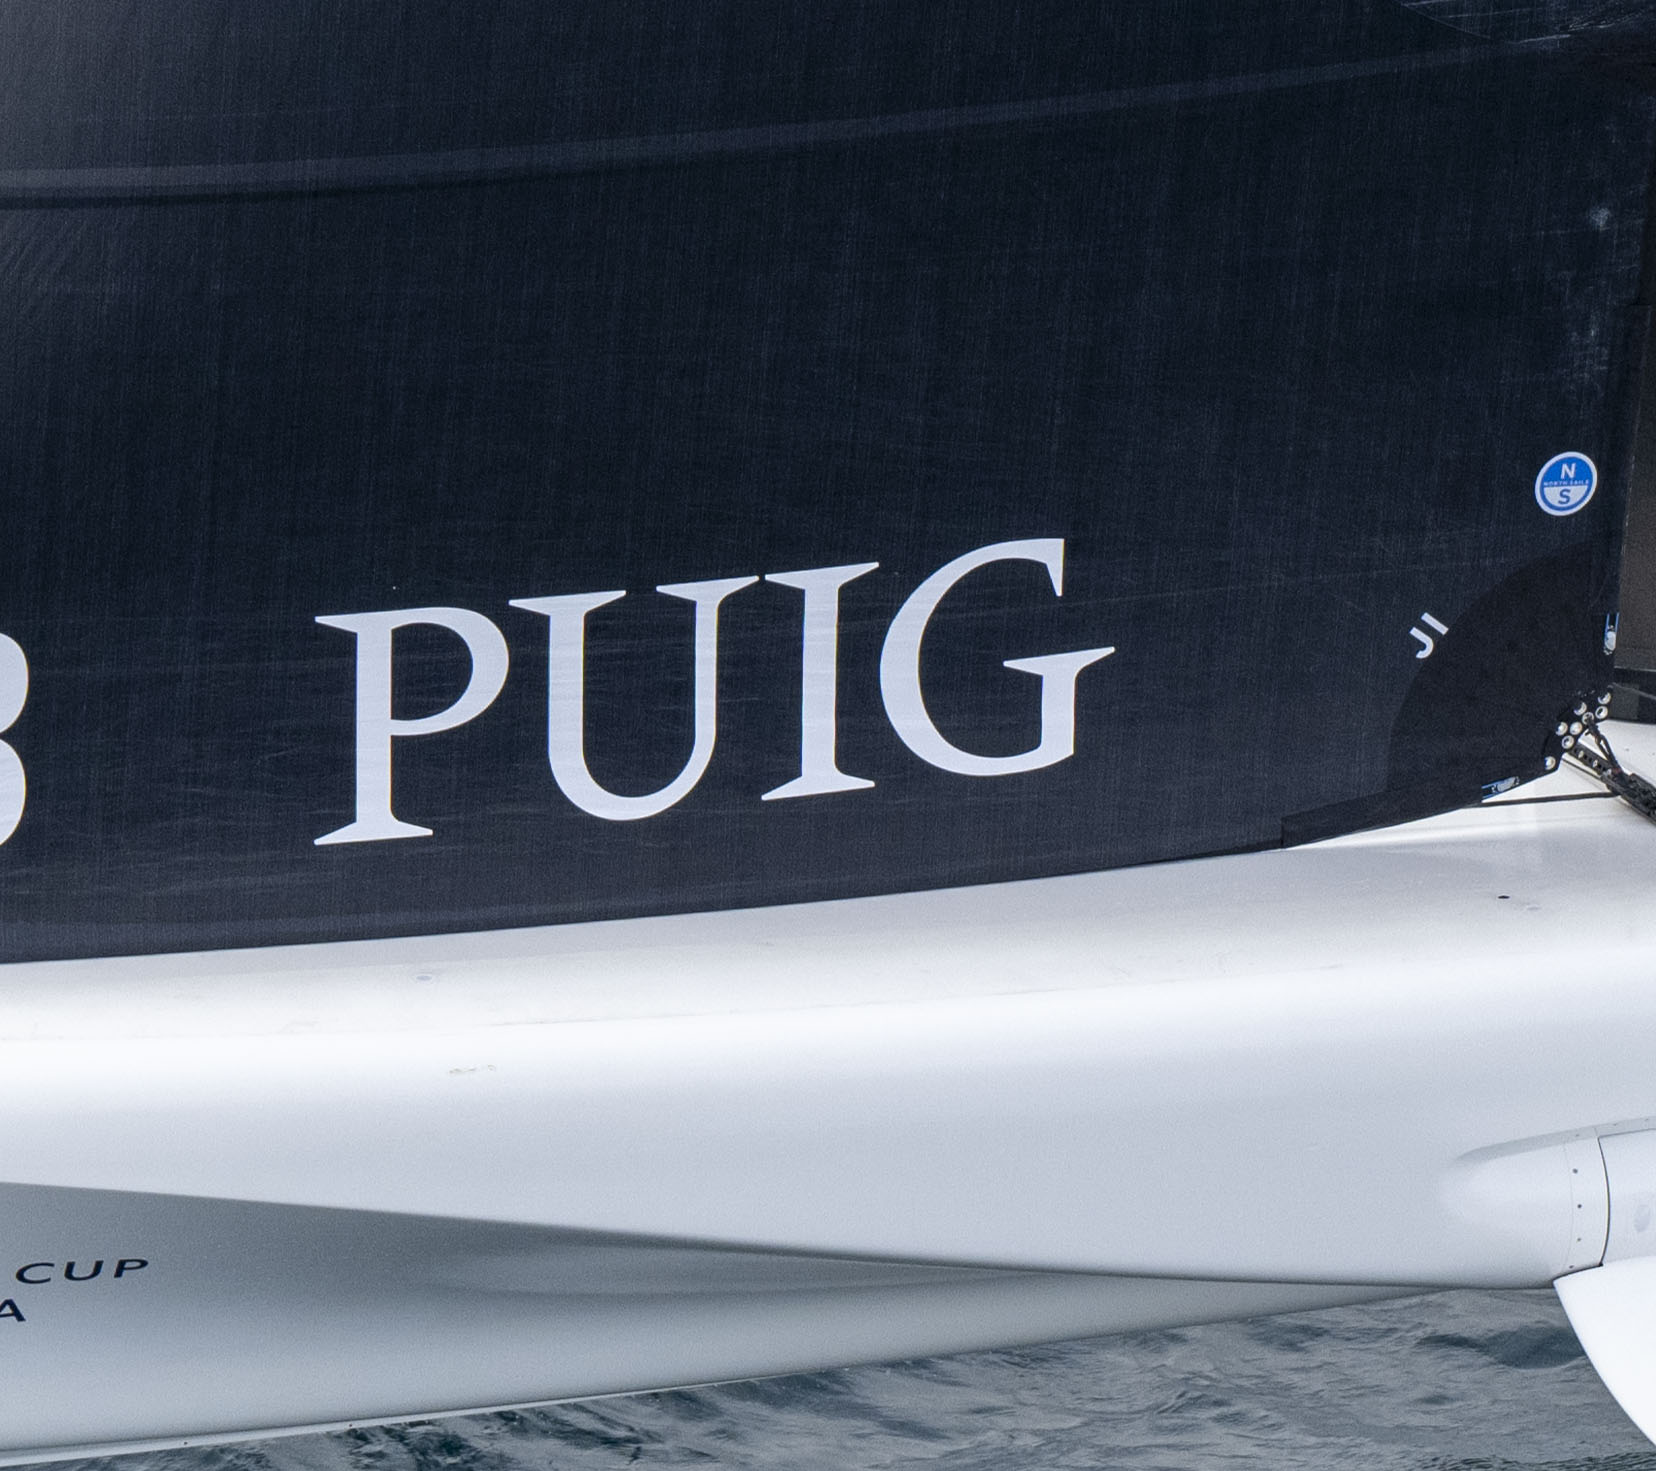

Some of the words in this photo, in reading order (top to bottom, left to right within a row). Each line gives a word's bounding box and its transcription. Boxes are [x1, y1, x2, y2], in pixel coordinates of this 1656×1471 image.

[1561, 463, 1576, 480] N
[1558, 488, 1571, 505] S
[313, 538, 1116, 846] PUIG
[15, 1257, 151, 1285] CUP
